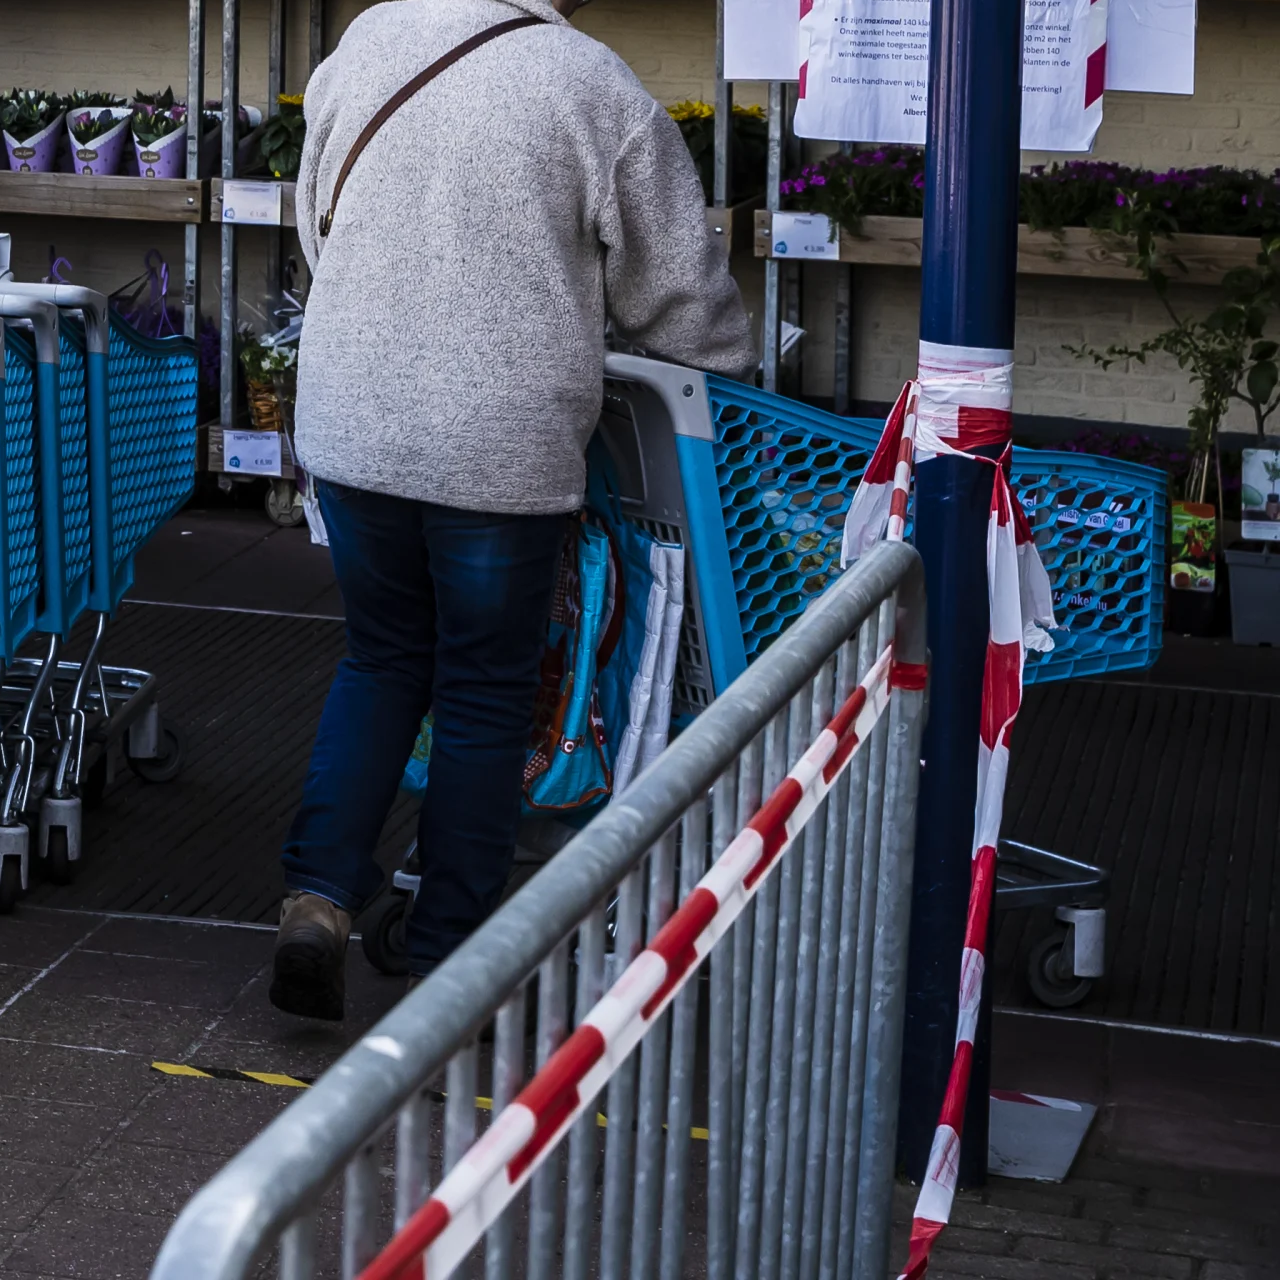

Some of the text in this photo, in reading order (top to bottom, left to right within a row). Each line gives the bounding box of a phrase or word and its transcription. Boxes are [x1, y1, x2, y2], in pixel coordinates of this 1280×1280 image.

[850, 17, 863, 25] zijn
[864, 17, 902, 25] maximaal
[860, 28, 884, 36] winkel
[887, 41, 927, 50] toegestaan
[838, 51, 890, 60] winkelwagens
[892, 52, 902, 60] ter
[862, 77, 902, 86] handhaven
[904, 80, 915, 88] wij
[916, 80, 926, 88] bij
[910, 94, 923, 102] We
[903, 108, 927, 116] Albert
